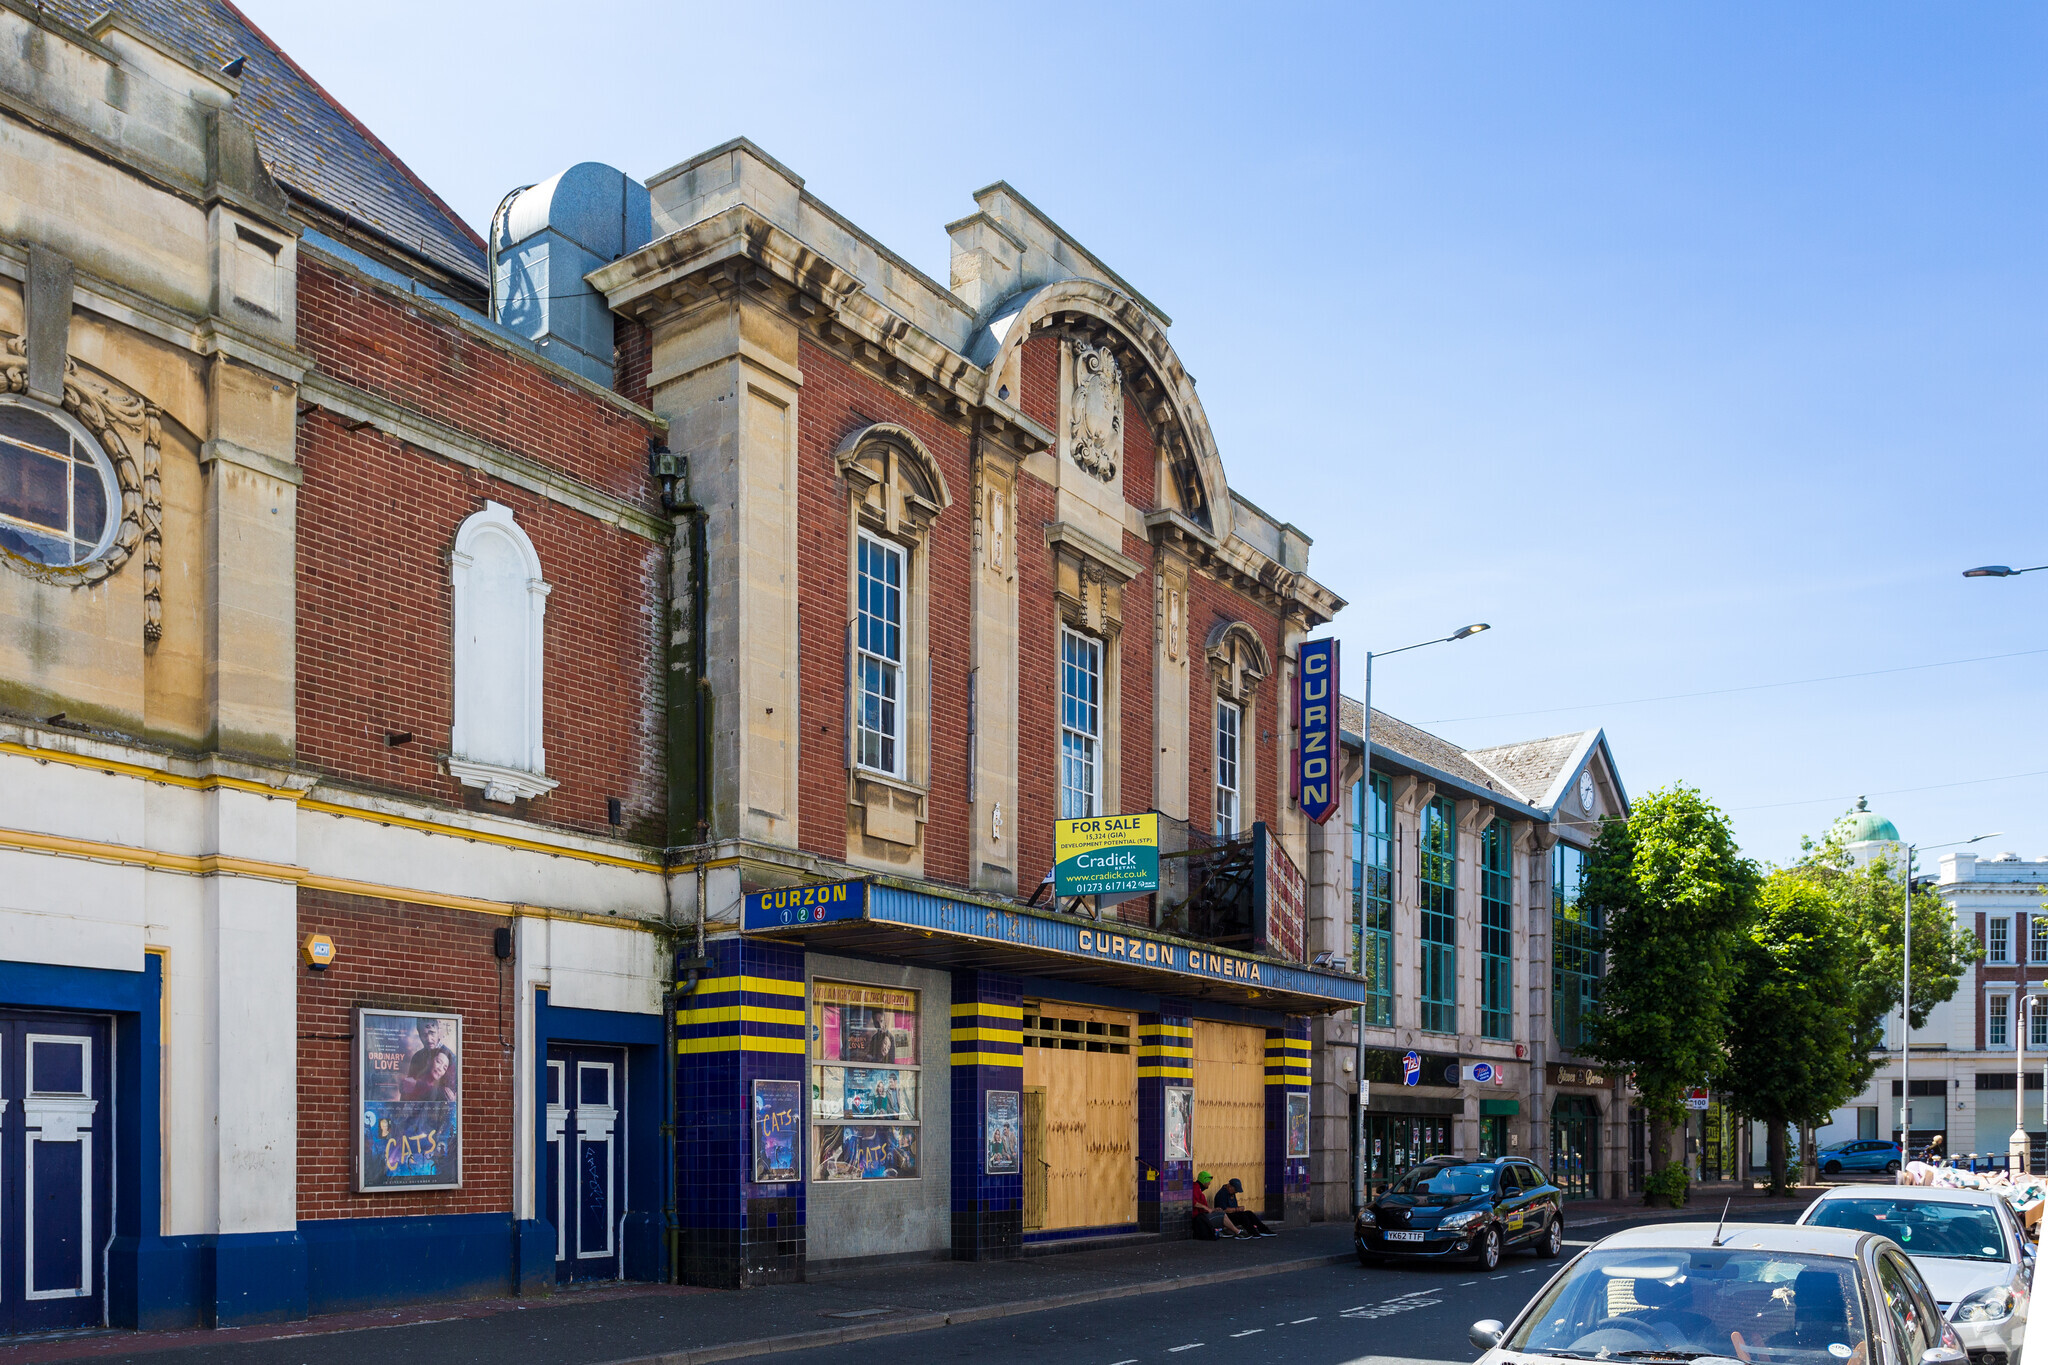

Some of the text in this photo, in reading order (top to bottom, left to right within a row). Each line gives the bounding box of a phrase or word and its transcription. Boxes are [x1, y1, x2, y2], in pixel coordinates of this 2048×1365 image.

[1303, 653, 1328, 806] CURZON
[1072, 818, 1140, 833] FOR SALE
[1107, 832, 1126, 840] (GIA)
[1061, 841, 1102, 849] DEVELOPMENT
[1077, 852, 1137, 868] Cradick
[1066, 869, 1147, 882] www.cradick.co.uk
[1077, 881, 1137, 893] 01273 617142
[761, 884, 847, 910] CURZON
[314, 945, 329, 955] ADT
[1079, 930, 1261, 981] CURZON CINEMA
[368, 1052, 405, 1061] ORDINARY
[374, 1060, 400, 1071] LOVE
[764, 1108, 792, 1137] CATS
[385, 1129, 437, 1171] CATS
[857, 1142, 887, 1174] CATS
[1388, 1231, 1424, 1241] YK62 TTF
